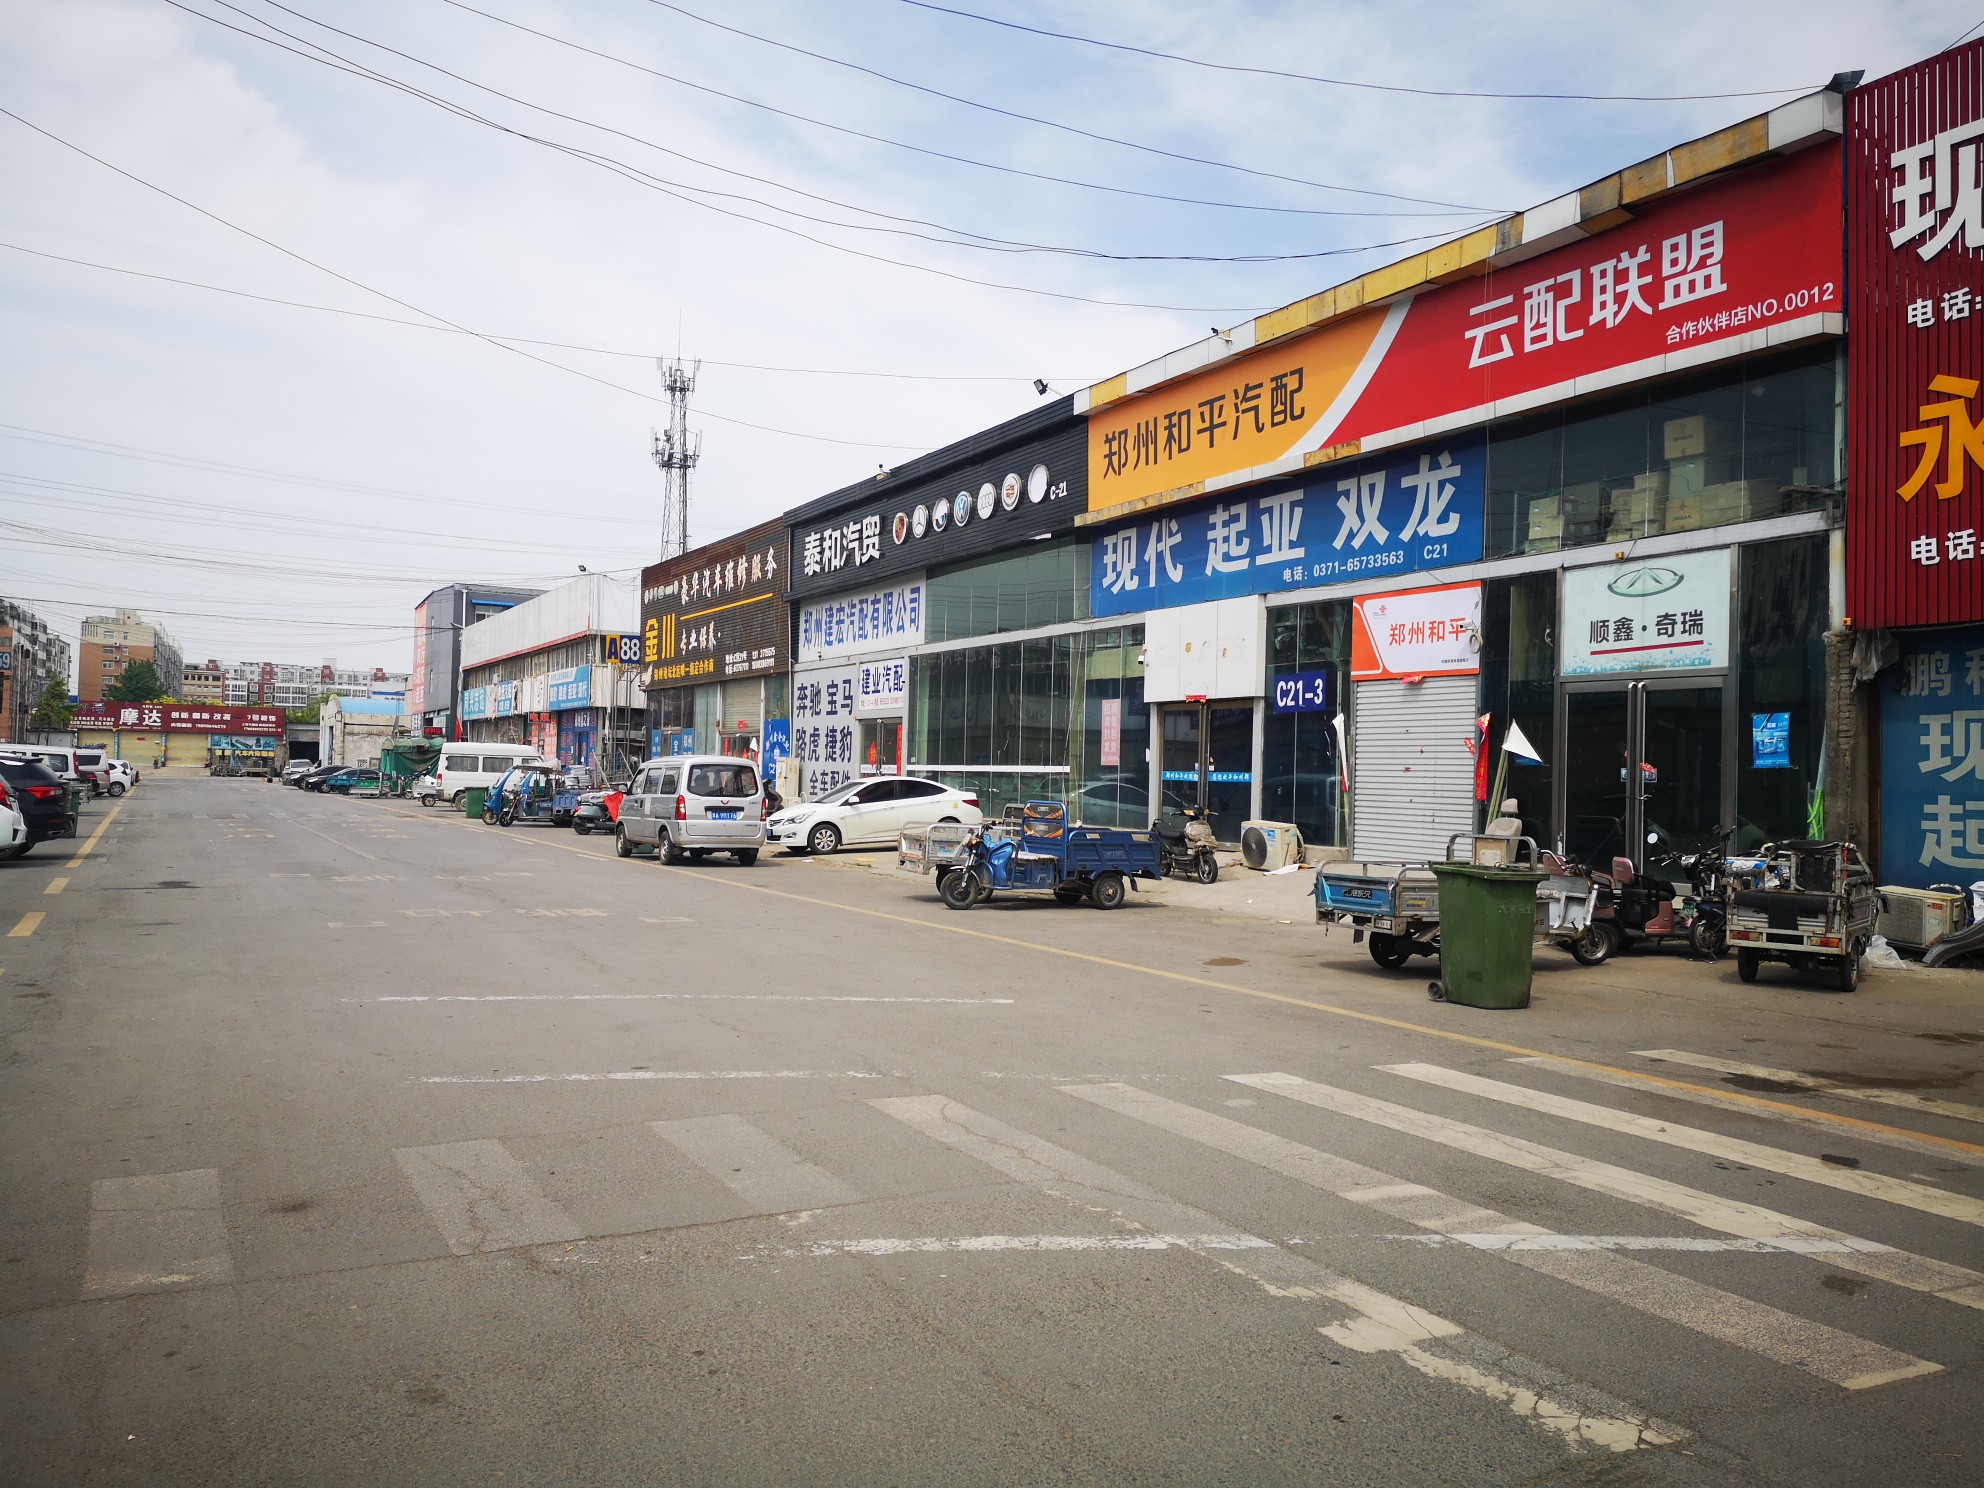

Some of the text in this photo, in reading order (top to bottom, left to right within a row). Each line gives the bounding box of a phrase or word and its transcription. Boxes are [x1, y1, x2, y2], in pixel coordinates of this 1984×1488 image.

[1464, 220, 1727, 369] 云配联盟
[1665, 282, 1834, 345] 合作伙伴店NO.0012
[1101, 366, 1305, 480] 郑州和平汽配
[1050, 481, 1068, 500] C-21
[1102, 451, 1461, 596] 现代 起亚 双龙
[803, 514, 881, 576] 泰和汽贸
[1313, 550, 1404, 577] 0371-65733563
[1424, 543, 1448, 560] C21
[645, 612, 676, 662] 金川
[803, 586, 921, 650] 郑州建宏汽配有限公司
[1389, 617, 1466, 646] 郑州和平
[796, 678, 853, 718] 奔驰 宝马
[860, 663, 904, 695] 建业汽配
[1277, 679, 1323, 708] C21-3
[119, 708, 162, 727] 摩达
[795, 726, 820, 763] 路虎
[825, 725, 852, 763] 捷豹
